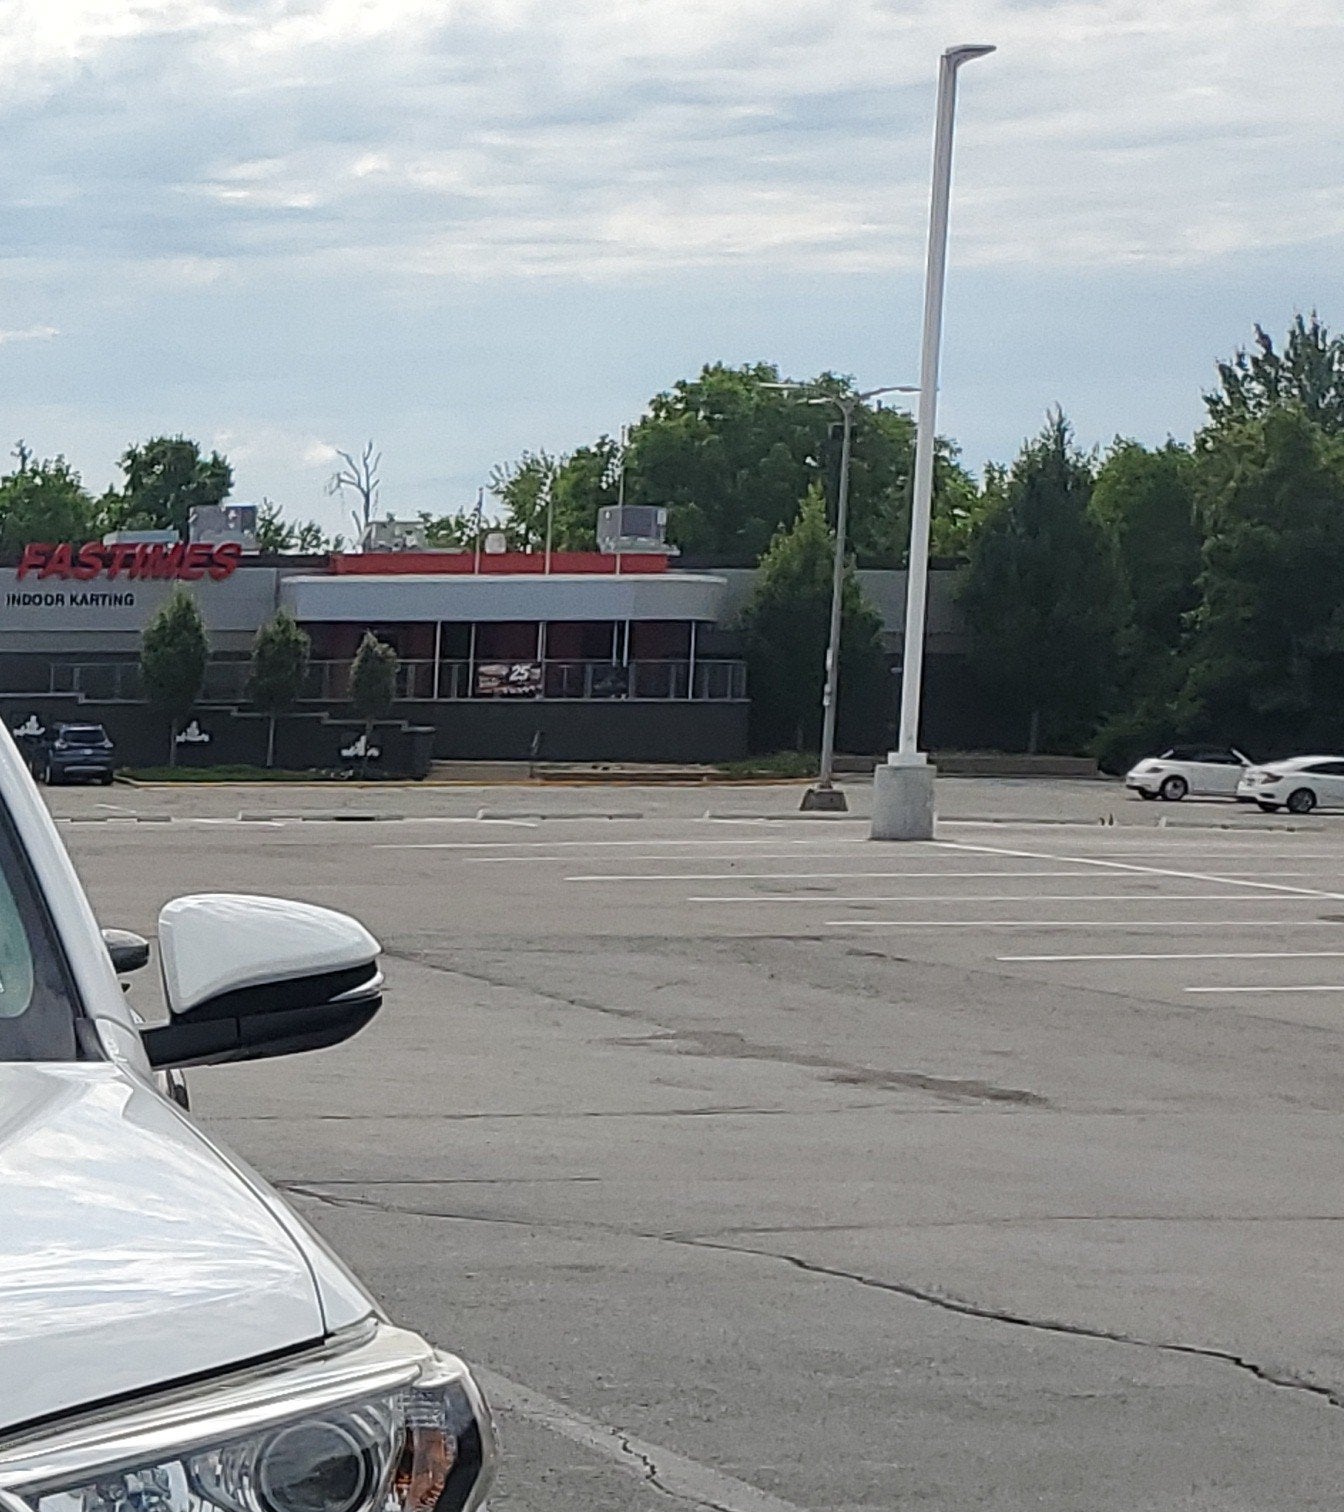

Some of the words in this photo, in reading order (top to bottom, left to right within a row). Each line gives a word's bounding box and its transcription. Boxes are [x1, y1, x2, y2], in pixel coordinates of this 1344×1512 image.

[16, 542, 242, 582] FASTIMES
[6, 593, 66, 608] INDOOR
[69, 593, 135, 607] KARTING
